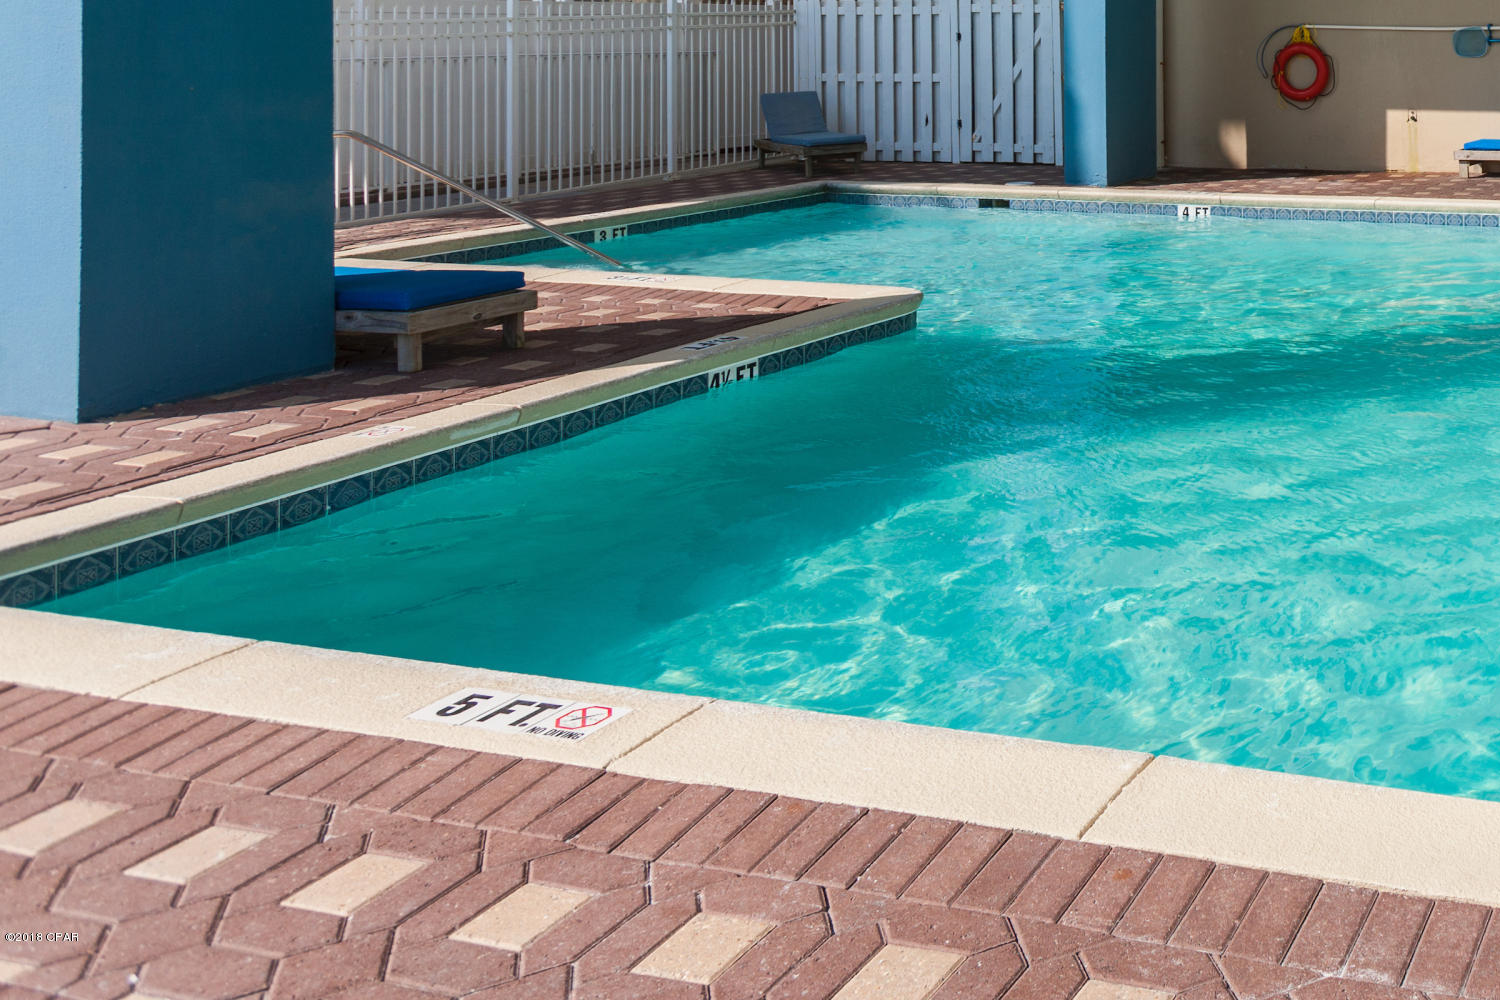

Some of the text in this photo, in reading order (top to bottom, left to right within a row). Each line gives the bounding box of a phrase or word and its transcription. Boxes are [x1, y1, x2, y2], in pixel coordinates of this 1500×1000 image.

[1182, 206, 1209, 218] 4 FT
[599, 226, 627, 242] 3 FT
[736, 361, 757, 382] FT
[435, 693, 564, 727] 5 FT.
[526, 726, 586, 741] NO DIVING
